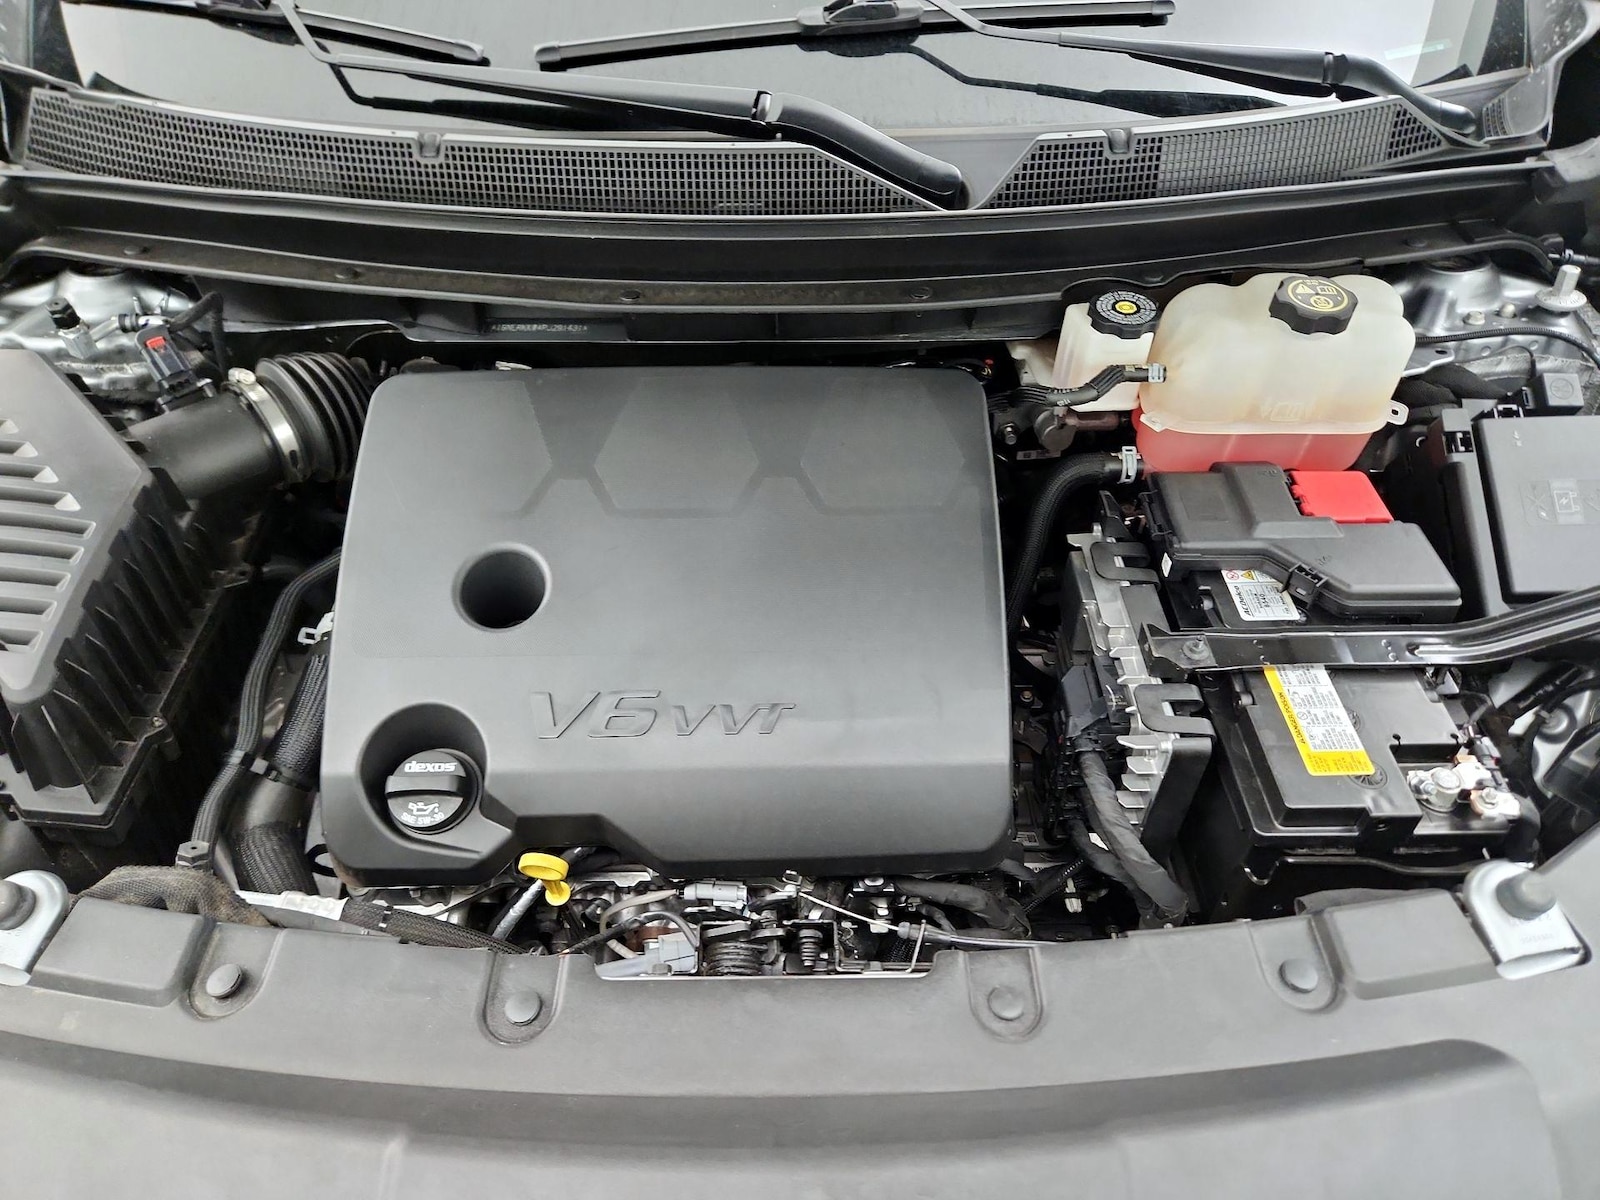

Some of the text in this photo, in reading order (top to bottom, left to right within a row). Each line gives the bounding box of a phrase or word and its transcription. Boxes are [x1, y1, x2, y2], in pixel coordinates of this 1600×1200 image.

[1234, 585, 1252, 616] ACDelco
[531, 690, 796, 739] V6 VVT
[405, 761, 457, 772] dexos
[402, 812, 444, 824] SAE 5W-30
